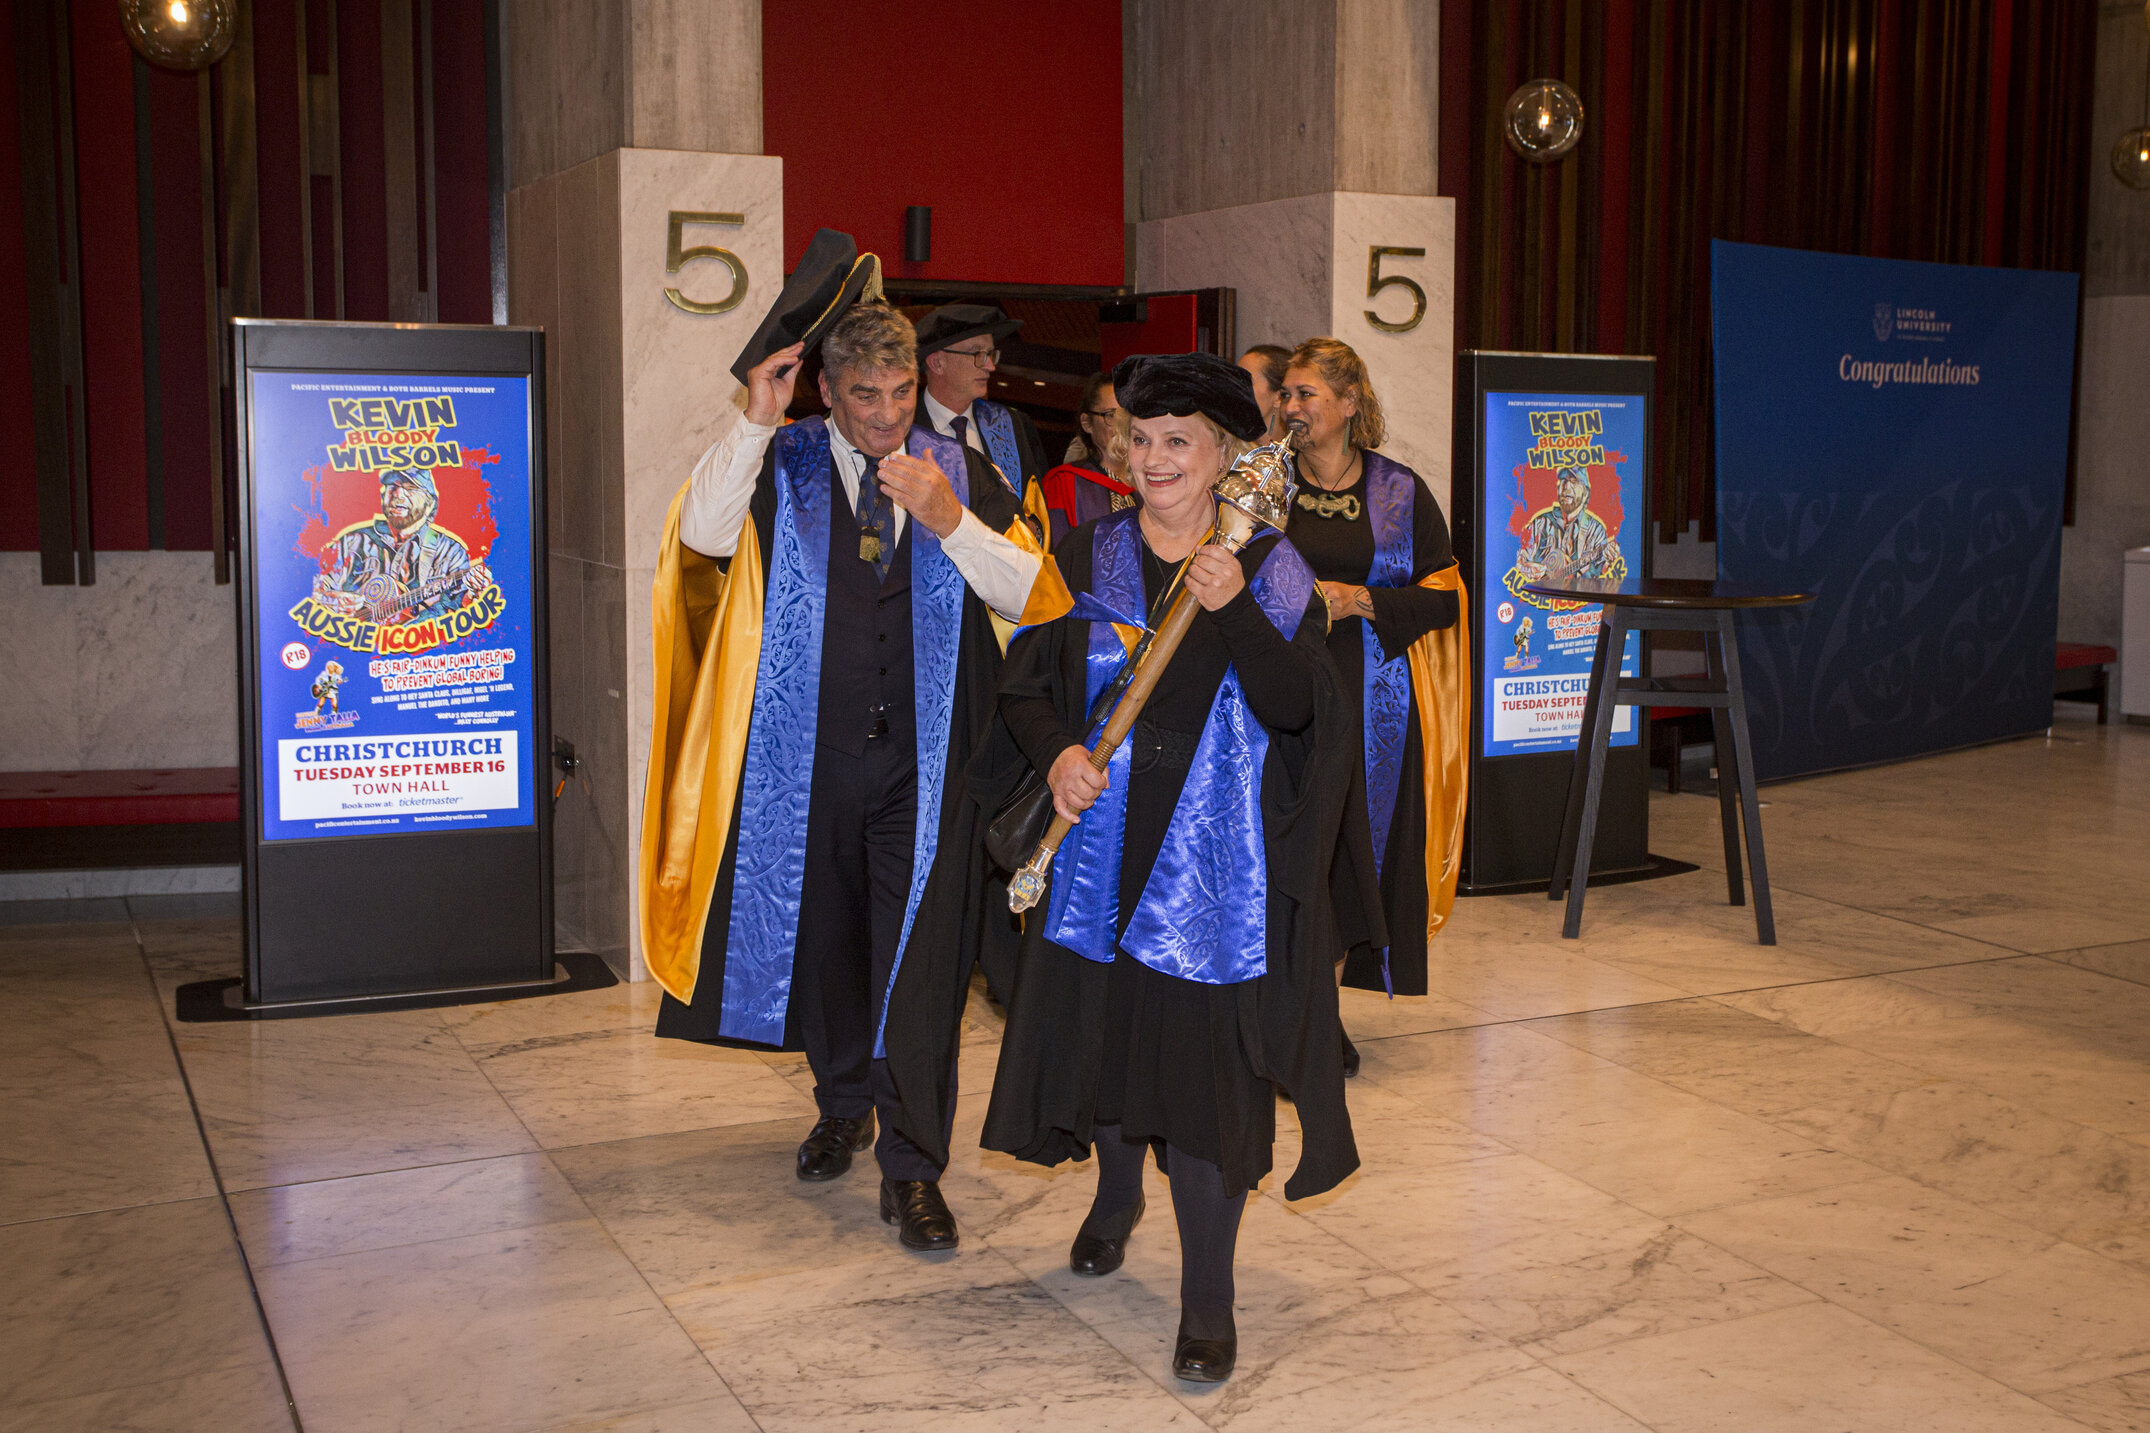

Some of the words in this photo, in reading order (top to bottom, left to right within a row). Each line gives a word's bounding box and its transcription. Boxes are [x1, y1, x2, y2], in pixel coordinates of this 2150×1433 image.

[664, 210, 749, 315] 5
[1363, 245, 1427, 333] 5
[1896, 308, 1936, 320] LINCOLN
[1896, 320, 1952, 333] UNIVERSITY
[1839, 353, 1980, 388] Congratulations
[321, 384, 381, 392] ENTERTAINMENT
[329, 396, 457, 430] KEVIN
[1529, 410, 1603, 437] KEVIN
[348, 429, 438, 445] BLOODY
[1539, 435, 1592, 448] BLOODY
[327, 441, 462, 472] WILSON
[1527, 445, 1604, 469] WILSON
[438, 586, 505, 642] TOUR
[1499, 607, 1512, 619] R18
[291, 598, 376, 651] AUSSIE
[379, 620, 438, 653] ICON
[285, 649, 307, 664] R18
[370, 661, 390, 676] HE'S
[391, 655, 446, 673] FAIR-DINKUM
[448, 652, 478, 668] FUNNY
[479, 649, 515, 665] HELPING
[382, 677, 394, 691] TO
[395, 673, 433, 689] PREVENT
[435, 669, 467, 685] GLOBAL
[468, 666, 503, 682] BORING!
[1503, 679, 1590, 697] CHRISTCHU
[1502, 699, 1548, 711] TUESDAY
[1551, 696, 1587, 709] SEPTE
[294, 714, 328, 730] JENNY
[1535, 711, 1564, 722] TOWN
[295, 738, 503, 763] CHRISTCHURCH
[293, 765, 377, 782] TUESDAY
[379, 761, 484, 778] SEPTEMBER
[487, 760, 506, 773] 16
[352, 783, 403, 796] TOWN
[407, 780, 450, 793] HALL
[341, 801, 364, 810] Book
